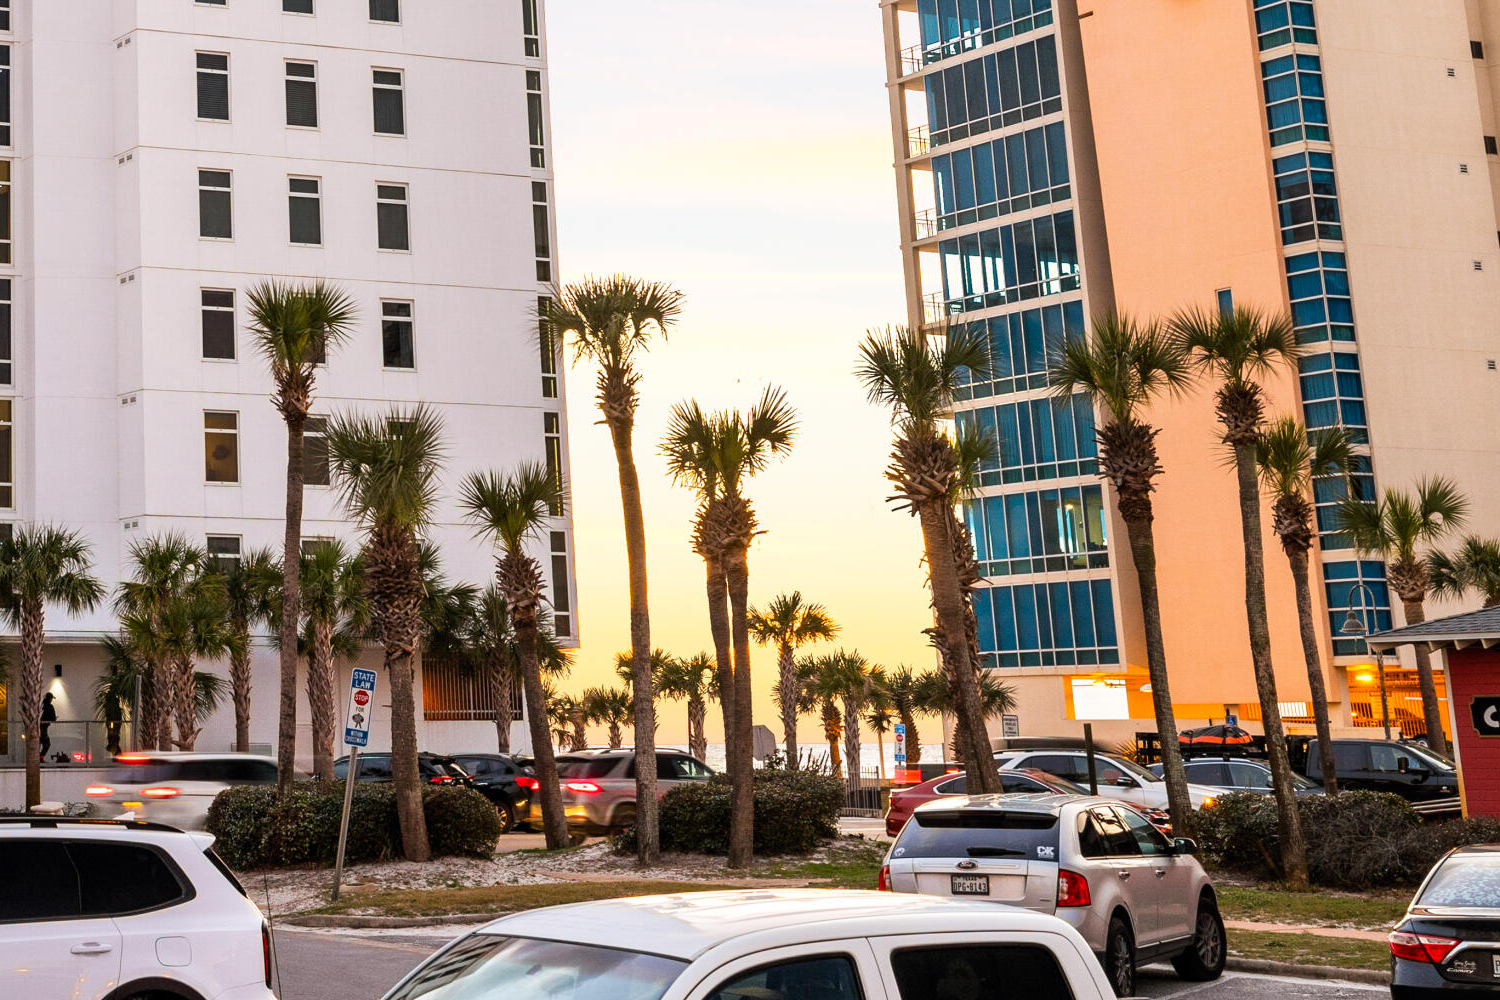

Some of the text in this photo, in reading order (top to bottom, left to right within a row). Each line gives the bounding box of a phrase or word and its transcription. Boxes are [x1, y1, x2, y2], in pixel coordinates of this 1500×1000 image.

[354, 672, 375, 682] STATE
[355, 680, 371, 689] LAW
[354, 694, 368, 702] STOP
